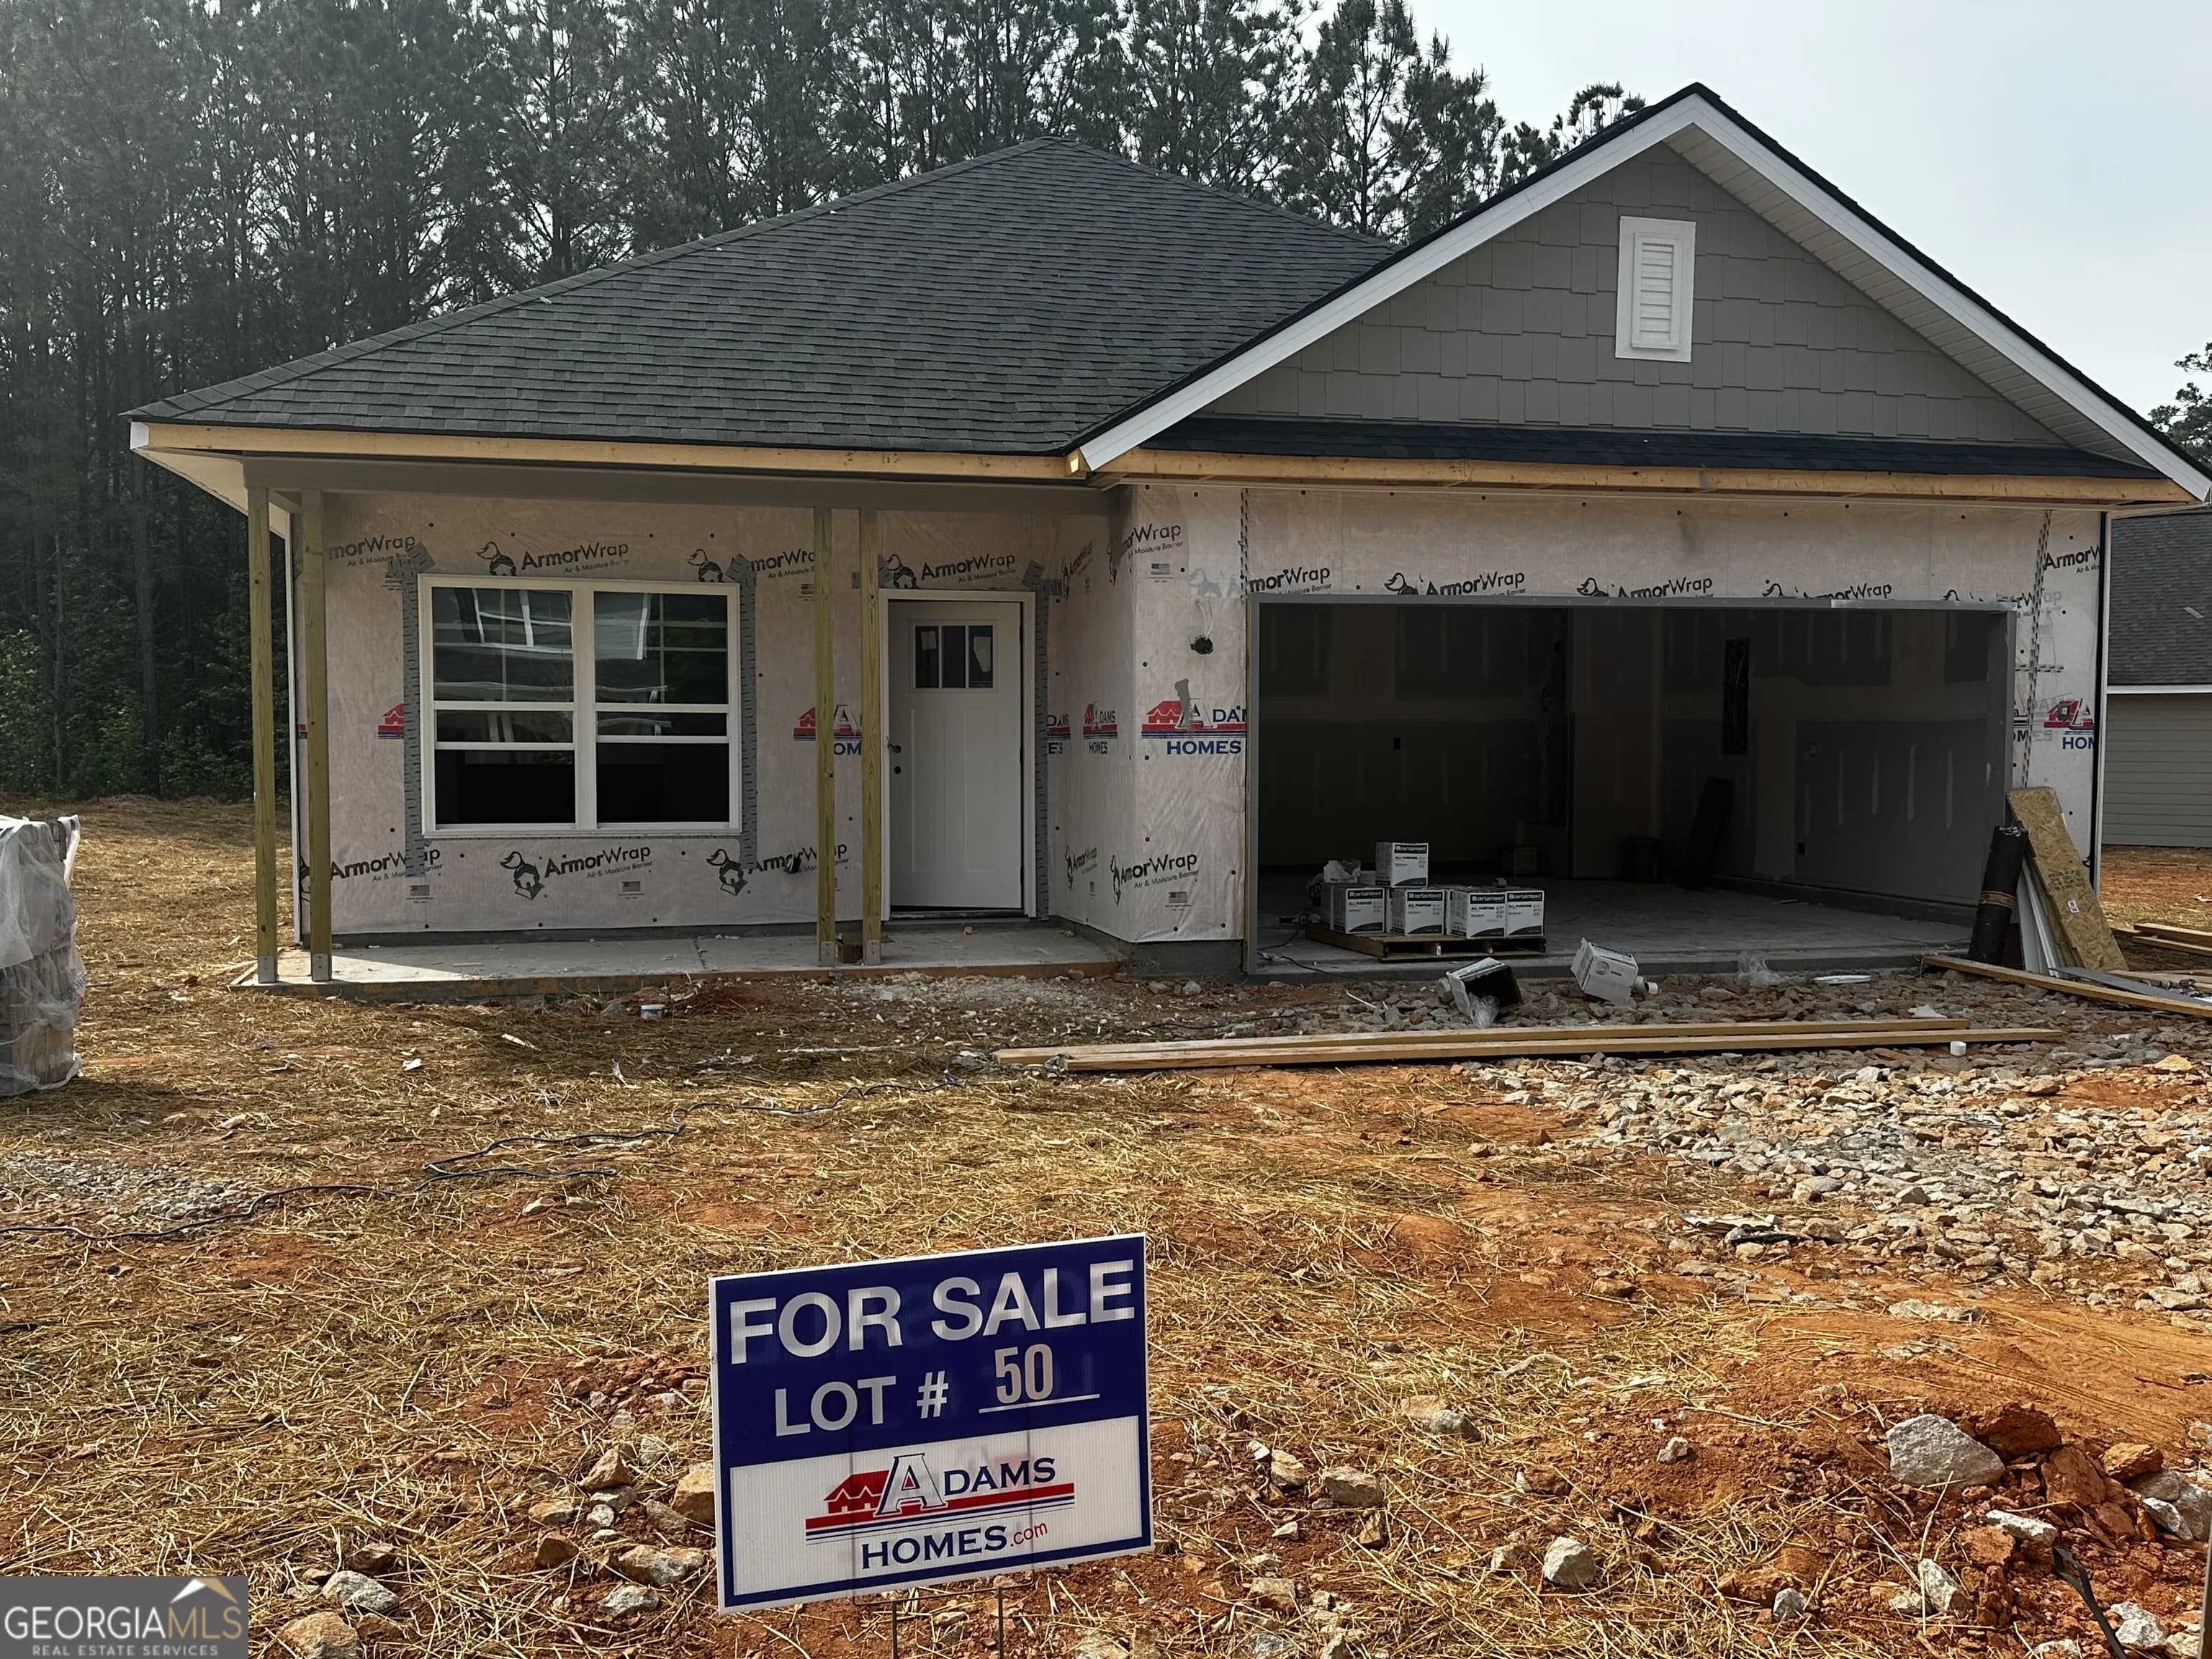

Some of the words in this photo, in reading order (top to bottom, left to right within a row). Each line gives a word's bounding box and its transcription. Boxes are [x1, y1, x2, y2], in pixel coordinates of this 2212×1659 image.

[328, 534, 415, 560] morWrap
[521, 542, 629, 570] ArmorWrap
[1162, 541, 1184, 550] Barrier
[2044, 545, 2100, 571] ArmorW
[921, 553, 1015, 580] ArmorWrap
[1249, 567, 1330, 593] morWrap
[1311, 583, 1331, 592] Barrier
[1426, 571, 1525, 595] ArmorWrap
[1167, 741, 1241, 755] HOMES
[331, 849, 441, 881] ArmorWp
[544, 847, 651, 878] ArmorWrap
[604, 866, 631, 875] Moisture
[632, 861, 652, 870] Barrier
[1120, 854, 1197, 884] ArmorWrap
[1151, 875, 1177, 885] Moisture
[1179, 870, 1199, 879] Barrier
[729, 1285, 903, 1364] FOR
[931, 1259, 1136, 1341] SALE
[775, 1375, 896, 1437] LOT
[916, 1370, 949, 1419] #
[994, 1344, 1053, 1404] 50
[876, 1452, 1056, 1516] ADAMS
